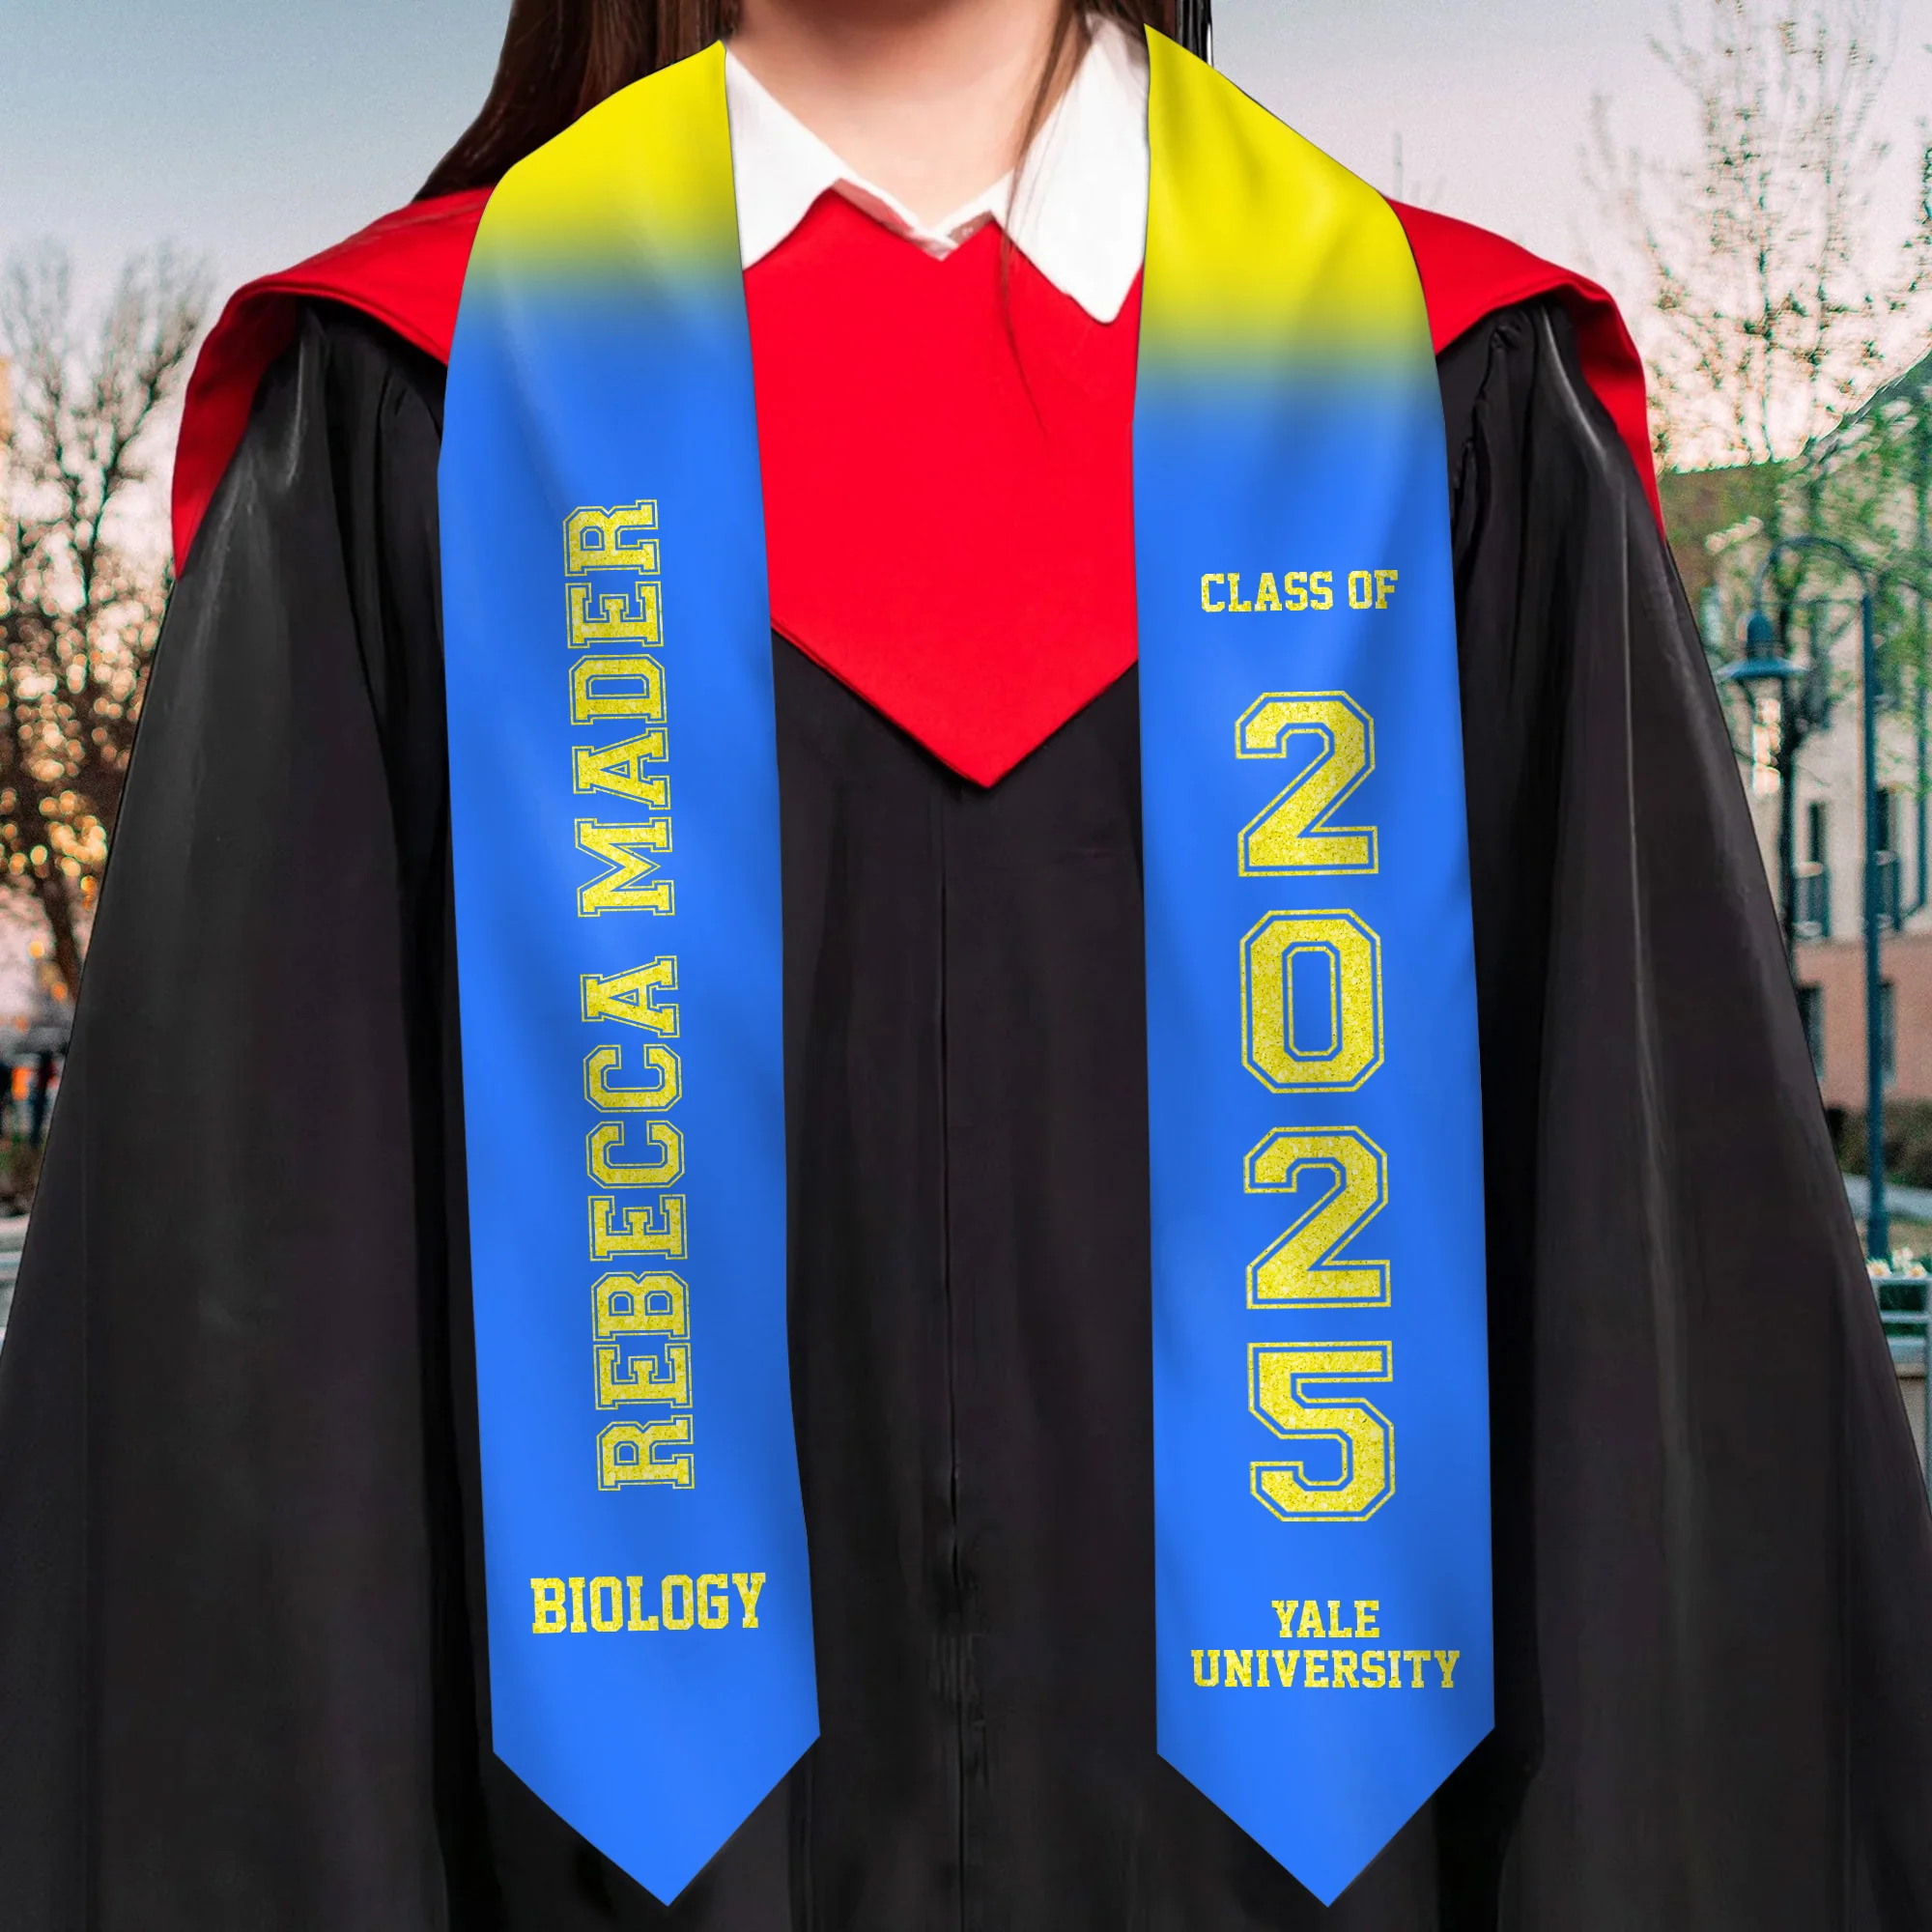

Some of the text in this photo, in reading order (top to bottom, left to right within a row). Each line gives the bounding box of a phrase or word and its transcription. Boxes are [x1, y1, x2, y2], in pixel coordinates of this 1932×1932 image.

[1200, 569, 1399, 613] CLASS OF
[562, 498, 696, 1492] REBECCA MADER
[1234, 689, 1397, 1523] 2025
[529, 1571, 766, 1635] BIOLOGY
[1270, 1600, 1380, 1638] YALE
[1190, 1649, 1461, 1689] UNIVERSITY
